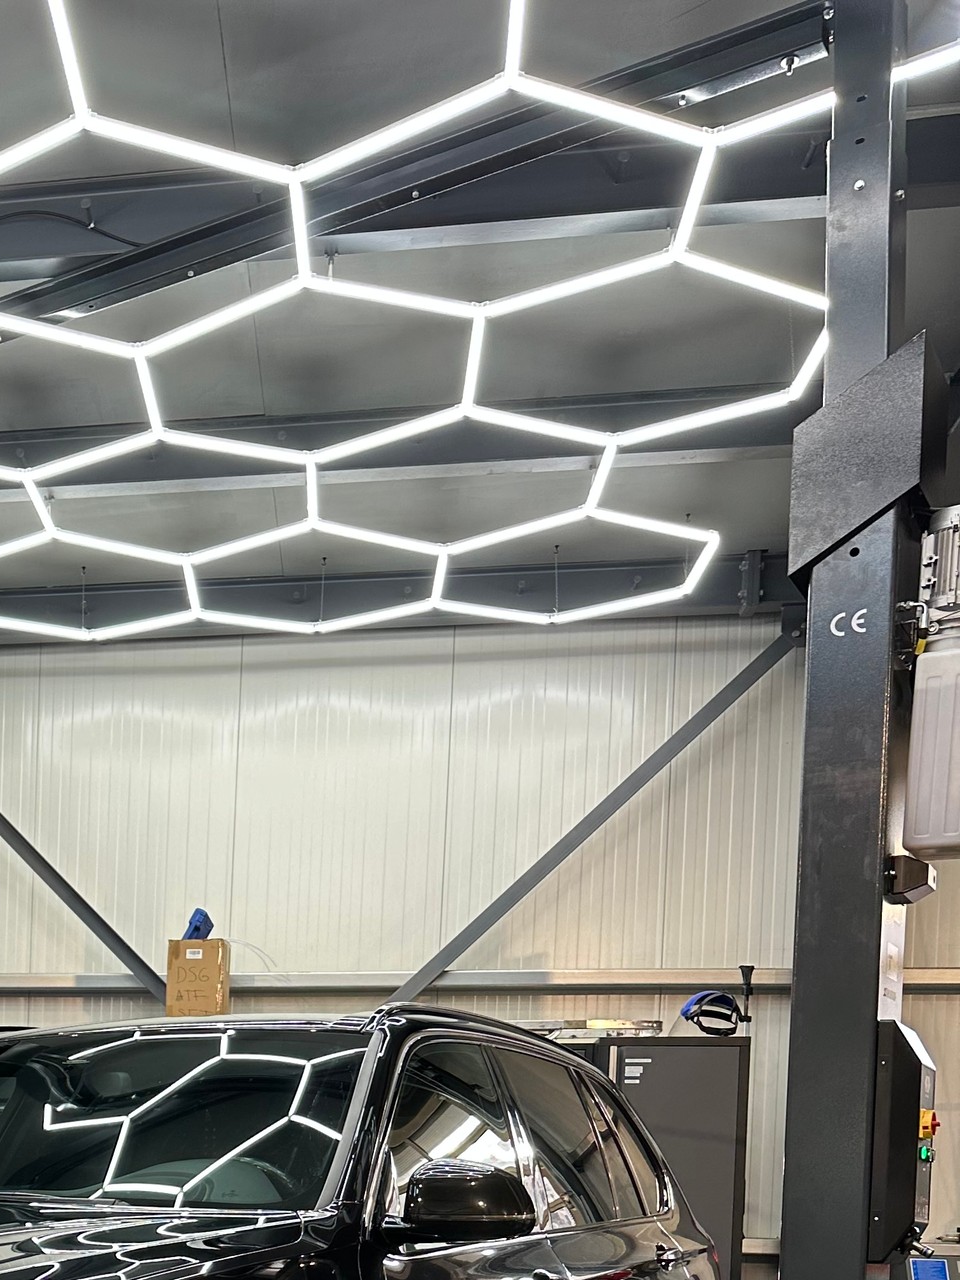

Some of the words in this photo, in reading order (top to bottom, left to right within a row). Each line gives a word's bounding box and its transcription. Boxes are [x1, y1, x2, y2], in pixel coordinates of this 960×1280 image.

[830, 608, 867, 637] CE
[176, 966, 210, 984] DSG
[175, 989, 209, 1001] ATF
